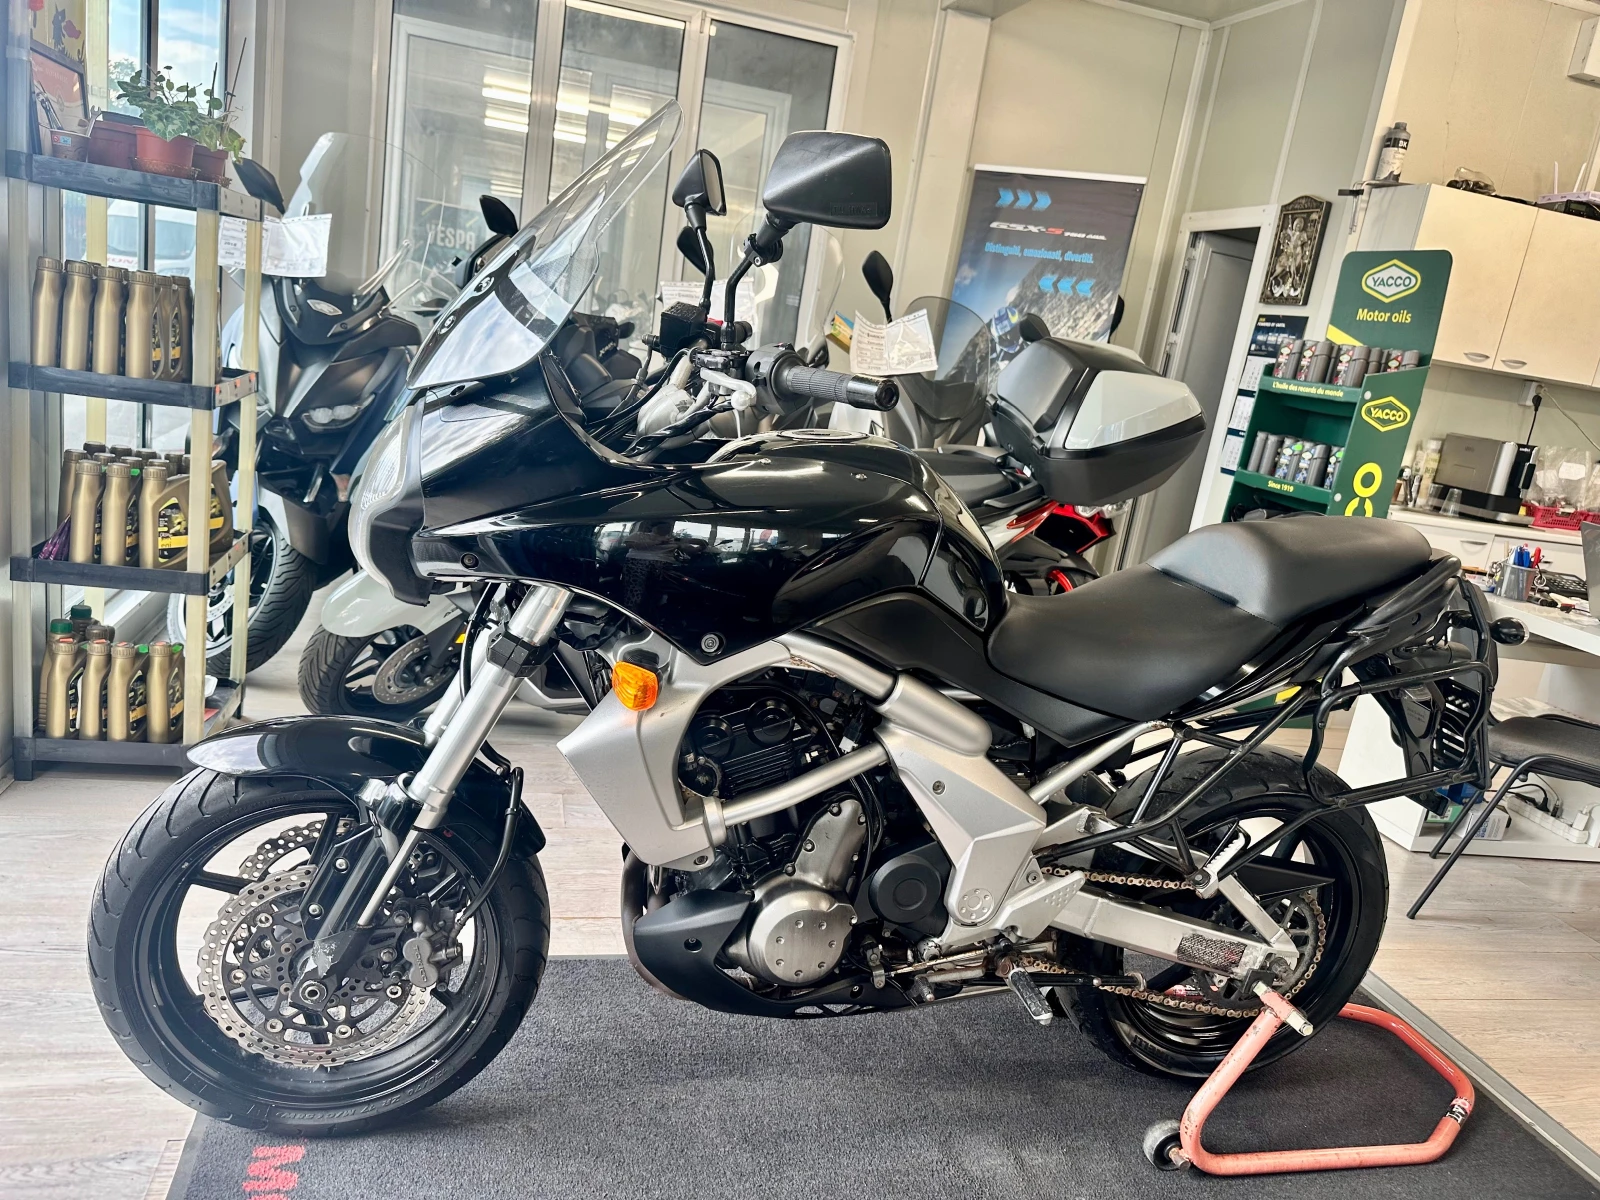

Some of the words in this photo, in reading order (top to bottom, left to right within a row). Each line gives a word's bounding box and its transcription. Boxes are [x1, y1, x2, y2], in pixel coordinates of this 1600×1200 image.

[426, 223, 476, 252] VESPA
[1372, 276, 1412, 289] YACCO
[1356, 308, 1390, 323] Motor
[1392, 309, 1412, 324] oils
[1272, 381, 1289, 391] L'huile
[1289, 383, 1298, 392] des
[1298, 386, 1317, 395] records
[1317, 387, 1325, 395] du
[1325, 388, 1344, 397] monde
[1370, 407, 1404, 422] YACCO
[1267, 480, 1281, 490] Since
[1281, 483, 1294, 492] 1919
[413, 945, 428, 983] TOKICO
